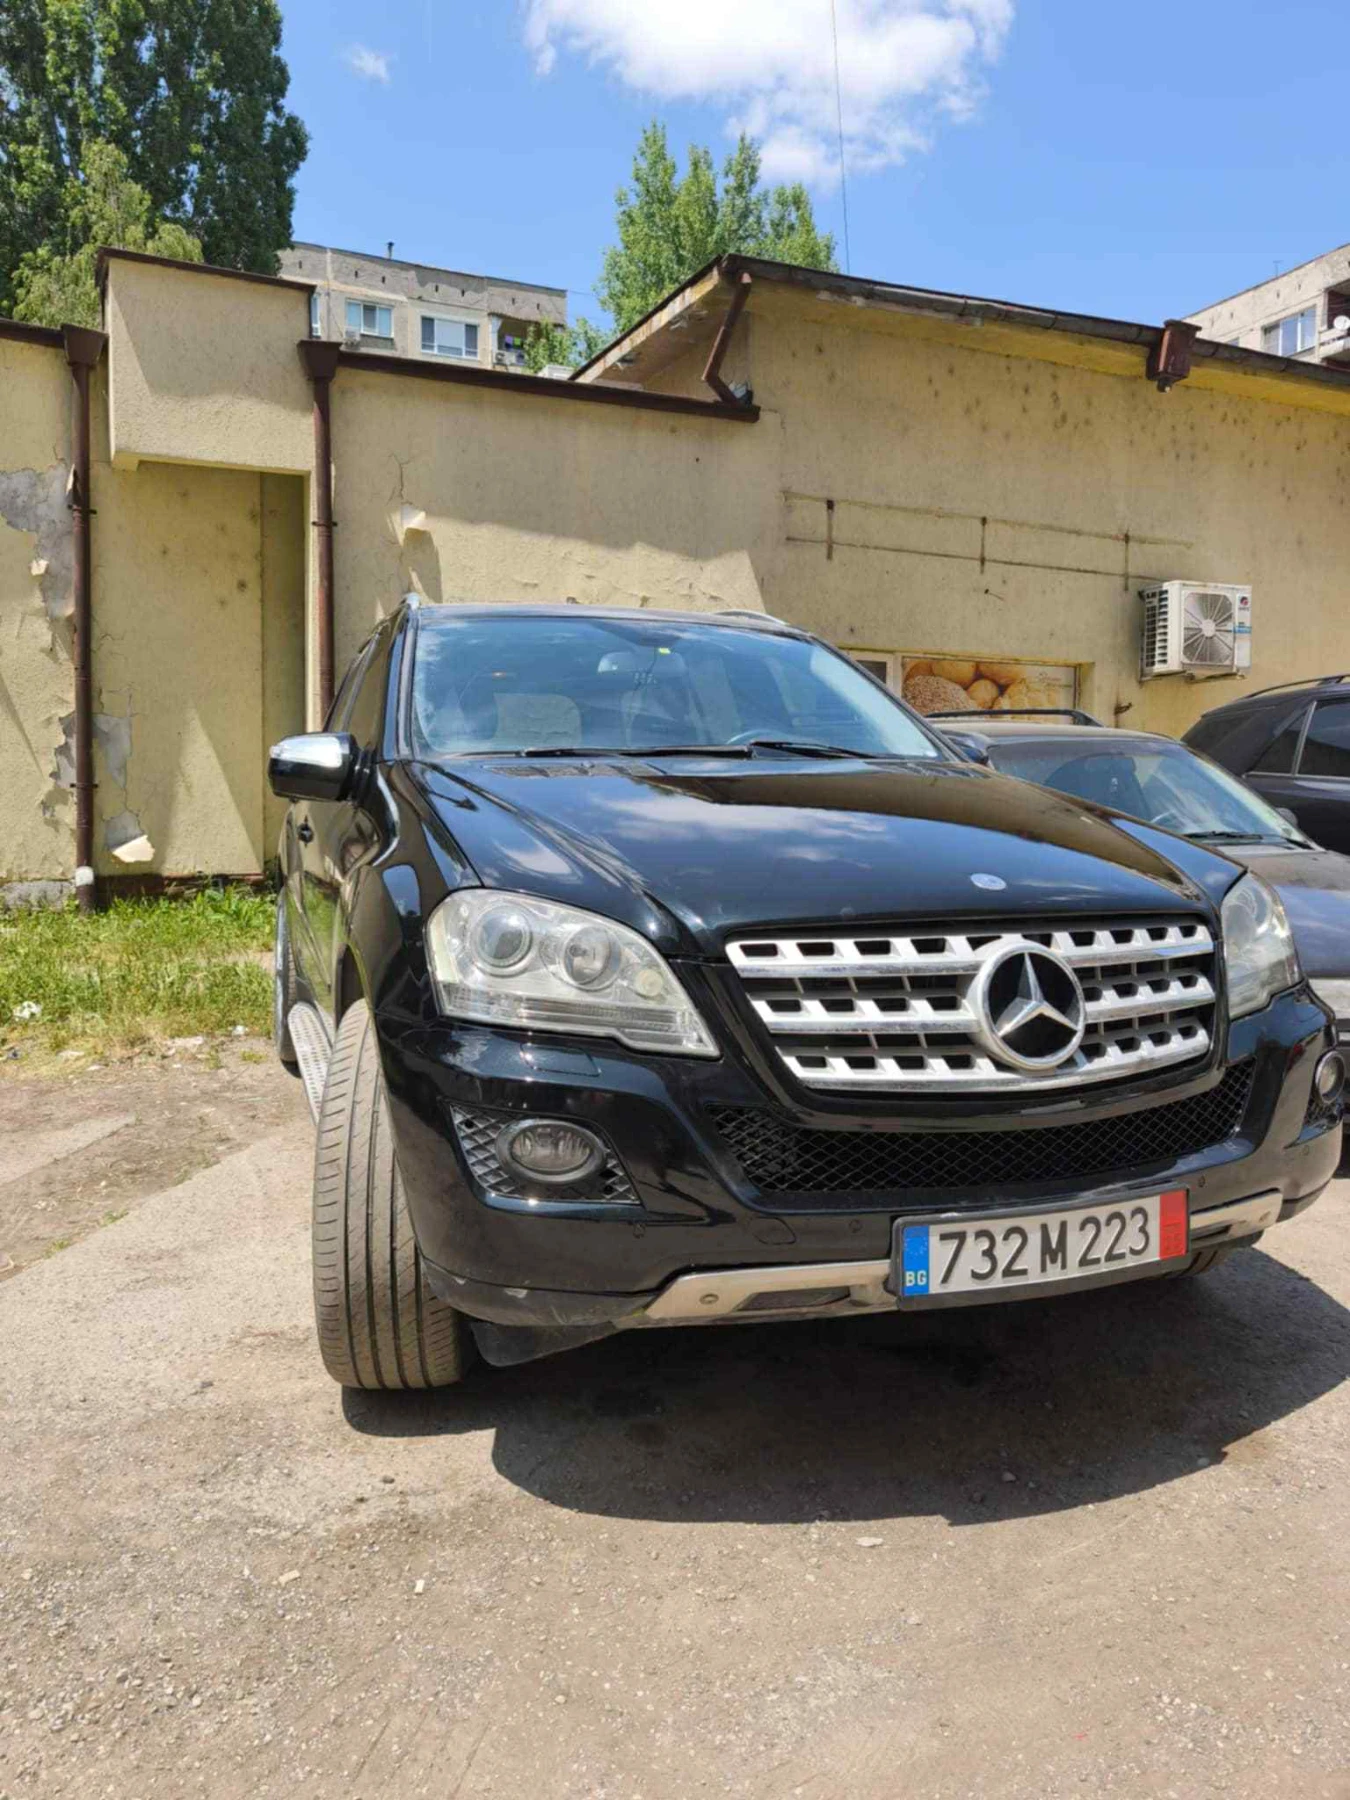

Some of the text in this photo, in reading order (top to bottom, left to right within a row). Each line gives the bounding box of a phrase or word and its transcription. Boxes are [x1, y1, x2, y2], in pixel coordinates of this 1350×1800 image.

[939, 1226, 1029, 1284] 732
[1039, 1220, 1068, 1273] M
[1077, 1207, 1149, 1268] 223
[904, 1271, 928, 1286] BG
